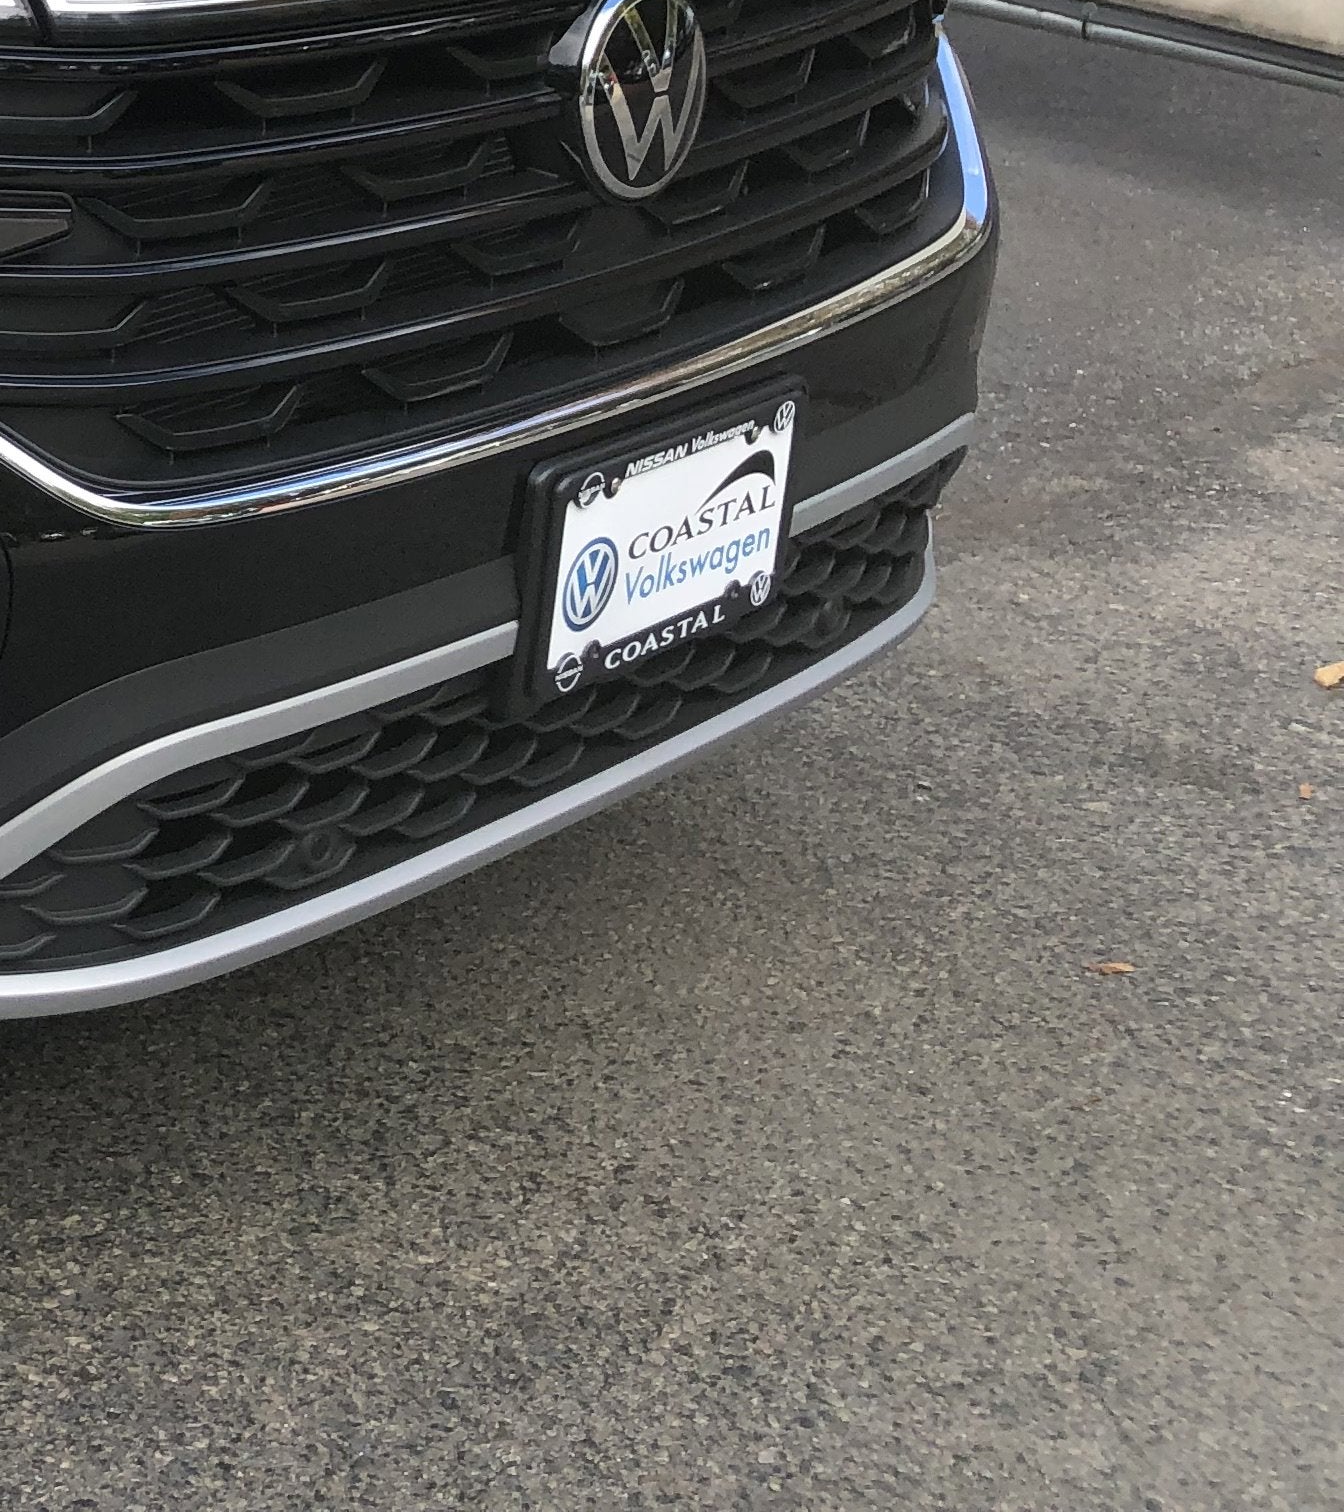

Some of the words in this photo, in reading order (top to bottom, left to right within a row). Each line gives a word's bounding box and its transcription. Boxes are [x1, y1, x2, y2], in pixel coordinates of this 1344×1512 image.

[625, 442, 689, 478] NISSAN
[691, 418, 756, 454] Volkswagen
[628, 484, 776, 560] COASTAL
[624, 527, 771, 605] Volkswagen
[604, 604, 726, 670] COASTAL
